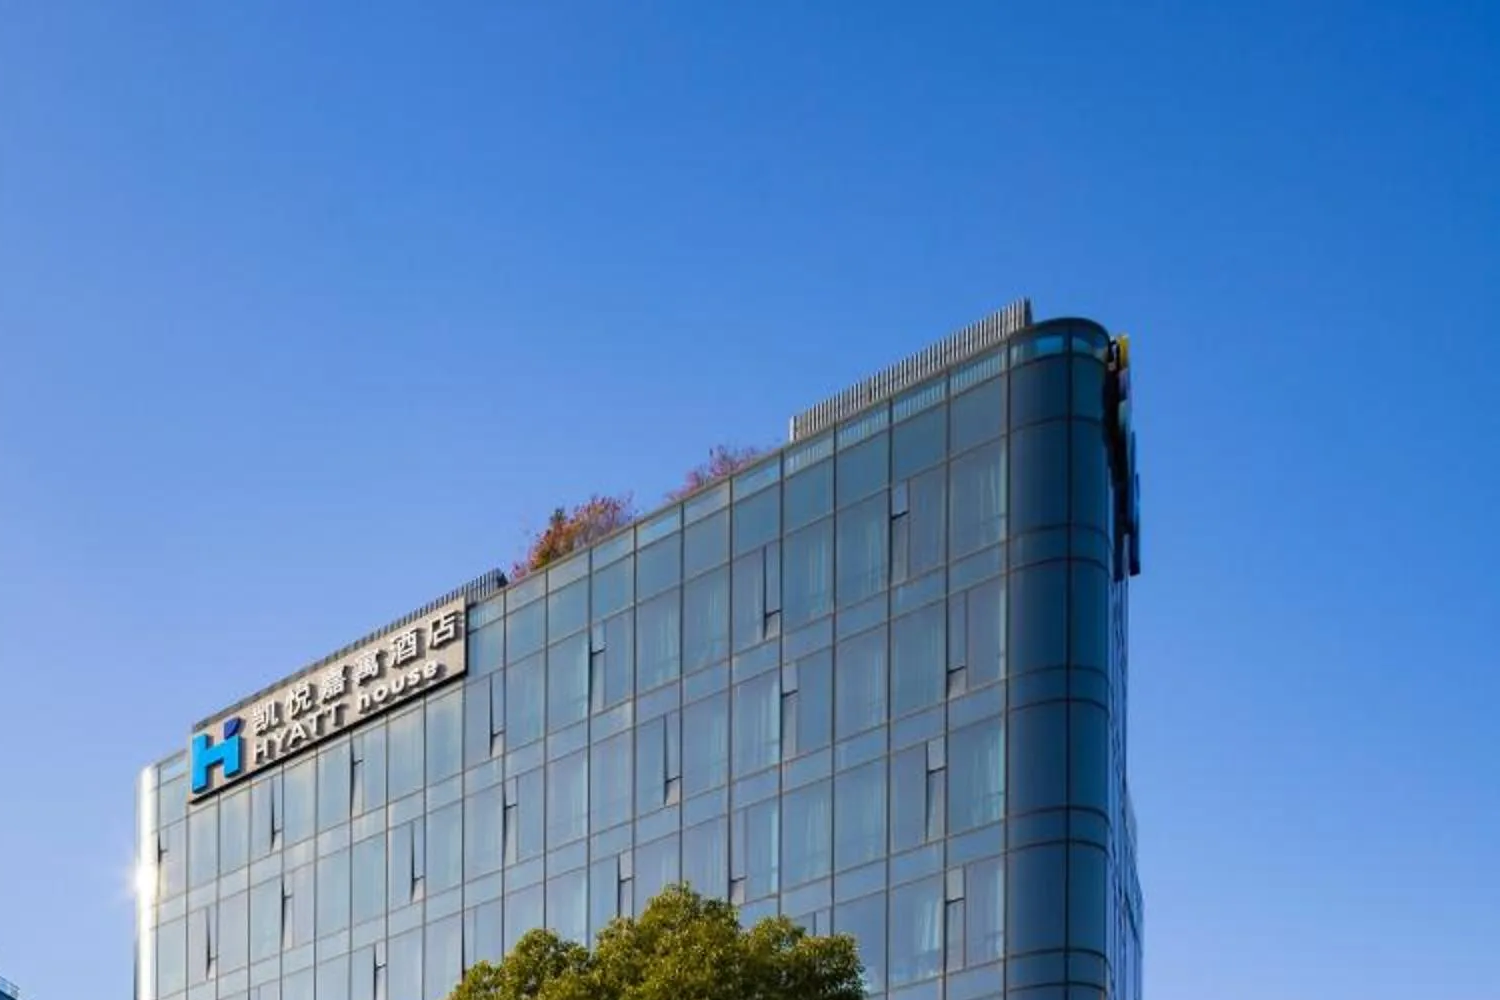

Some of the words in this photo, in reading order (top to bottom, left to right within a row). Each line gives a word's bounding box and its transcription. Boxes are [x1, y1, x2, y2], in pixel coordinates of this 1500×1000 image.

[251, 609, 459, 735] 凯悦嘉寓酒店
[253, 701, 342, 764] HYATT
[356, 660, 440, 714] house
